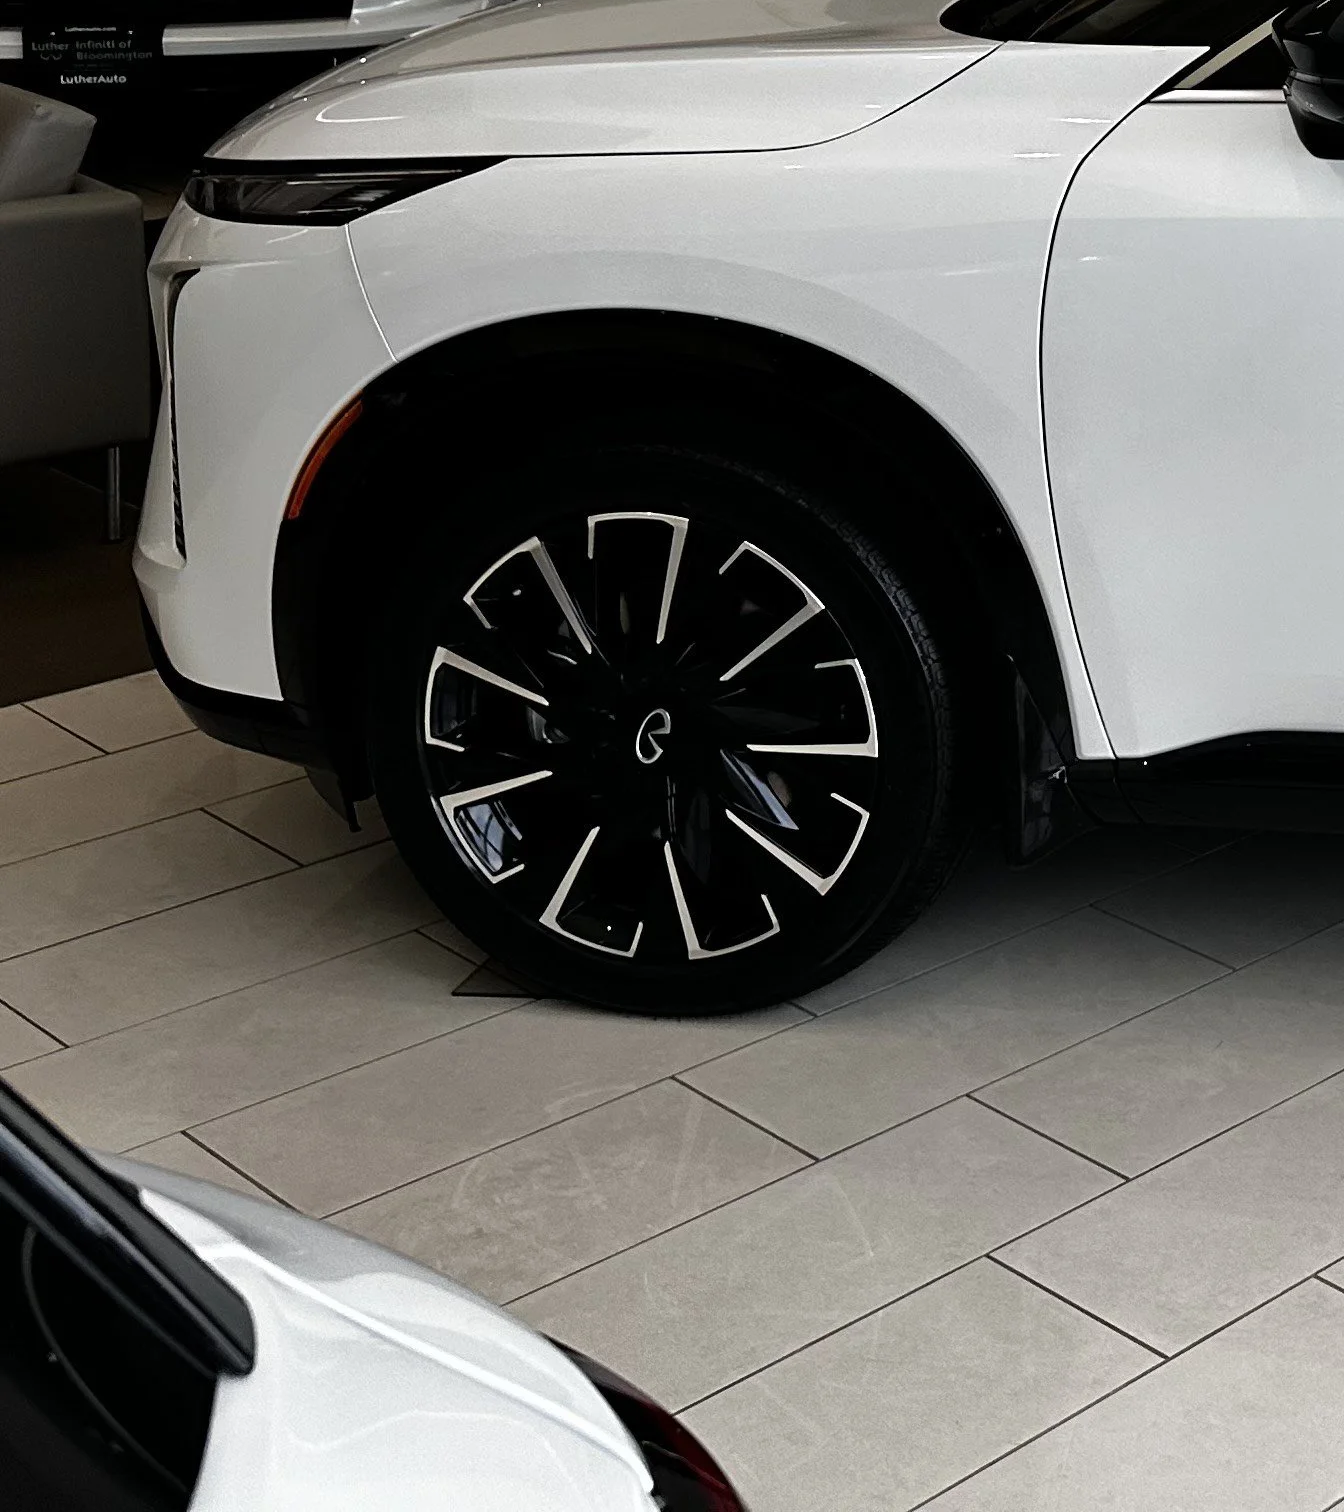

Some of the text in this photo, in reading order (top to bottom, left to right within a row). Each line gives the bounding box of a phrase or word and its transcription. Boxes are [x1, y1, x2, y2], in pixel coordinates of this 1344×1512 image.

[31, 41, 69, 52] Luther
[75, 39, 132, 49] Infiniti of
[76, 51, 153, 61] Bloomington
[60, 74, 127, 85] LutherAuto
